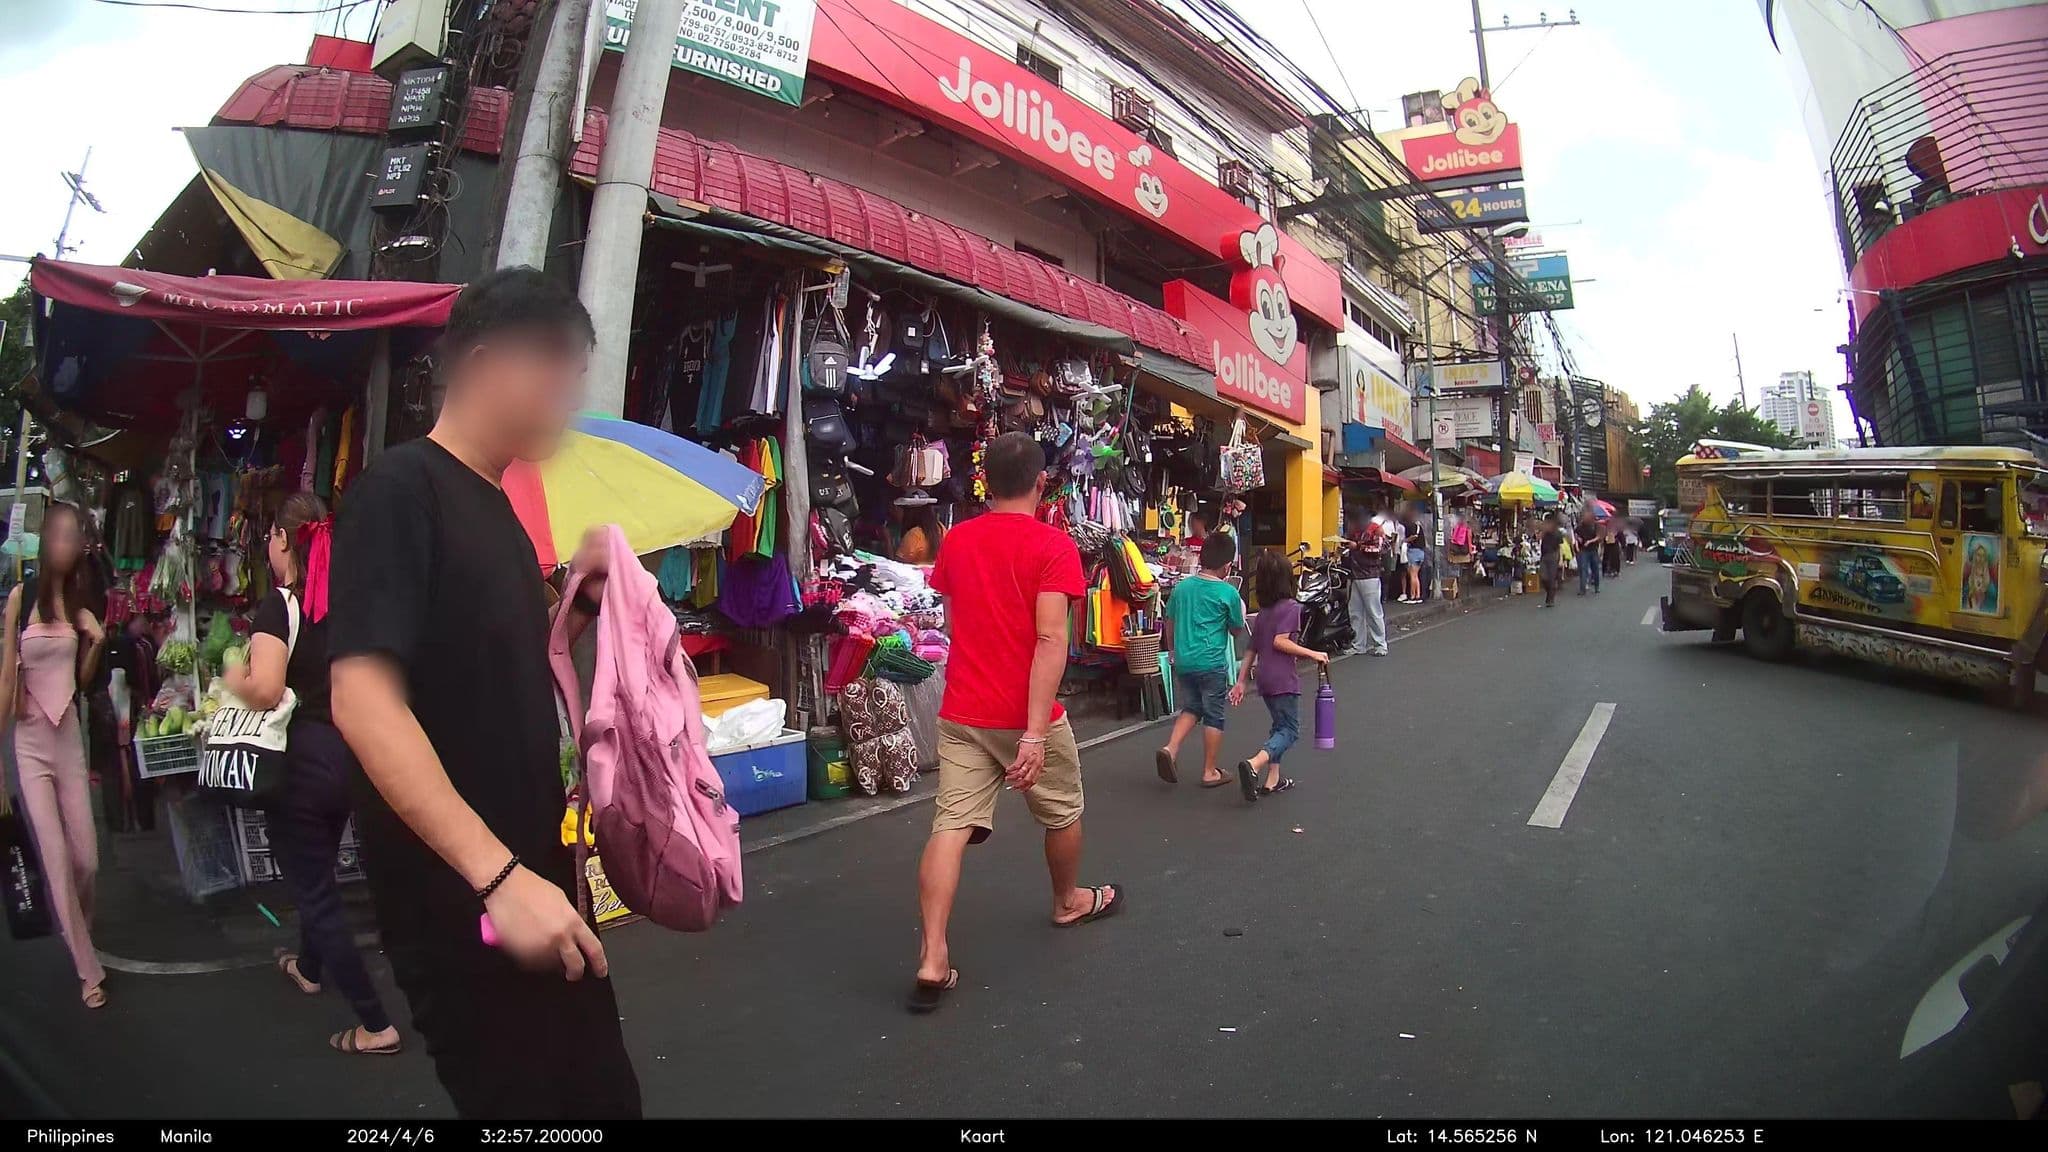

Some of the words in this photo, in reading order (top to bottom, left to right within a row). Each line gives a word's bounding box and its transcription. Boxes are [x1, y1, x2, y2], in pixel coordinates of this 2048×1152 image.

[694, 0, 781, 27] ENT
[938, 55, 1116, 181] Jollibee
[390, 156, 407, 165] MKT
[1422, 149, 1504, 173] Jollibee
[1451, 197, 1483, 219] 24
[1483, 199, 1522, 212] HOURS
[1213, 340, 1291, 409] Jollibee
[198, 749, 260, 791] WOMAN
